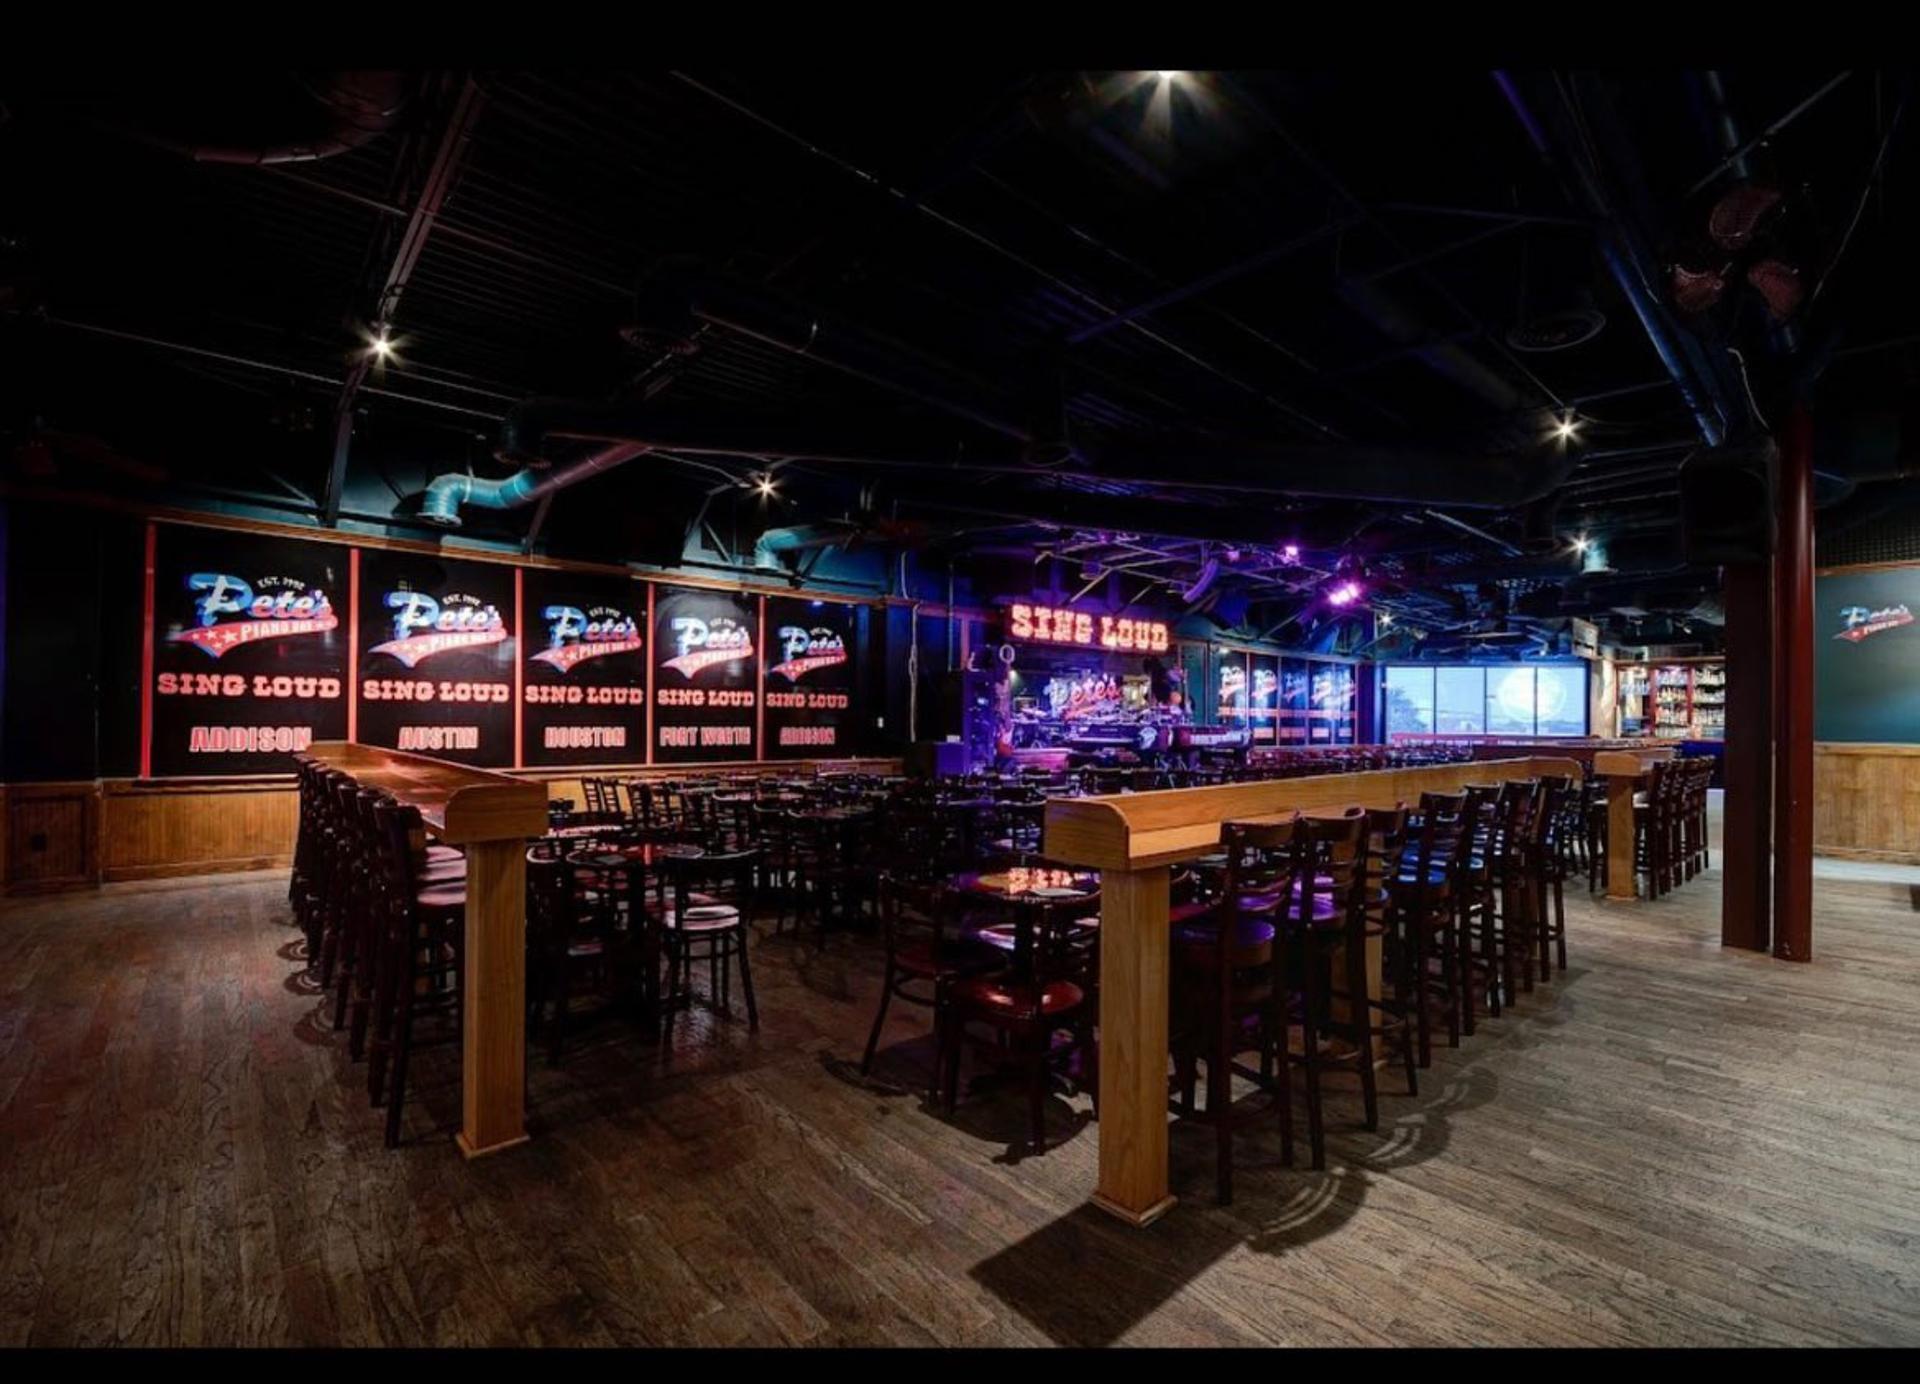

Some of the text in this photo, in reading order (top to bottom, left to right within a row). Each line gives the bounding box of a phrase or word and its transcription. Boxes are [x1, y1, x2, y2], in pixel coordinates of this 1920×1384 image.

[188, 572, 335, 628] Pete's
[385, 590, 504, 641] Pete's
[544, 605, 639, 648] Pete's
[1011, 604, 1169, 650] SING LOUD
[240, 619, 288, 642] PIANO
[671, 617, 752, 657] Pete's
[777, 626, 846, 662] Pete's
[158, 672, 341, 698] SING LOUD
[363, 680, 510, 702] SING LOUD
[525, 685, 643, 705] SING LOUD
[658, 689, 754, 707] SING LOUD
[766, 692, 848, 709] SING LOUD
[189, 726, 312, 753] ADDISON
[397, 726, 479, 750] AUSTIN
[544, 726, 626, 748] HOUSTON
